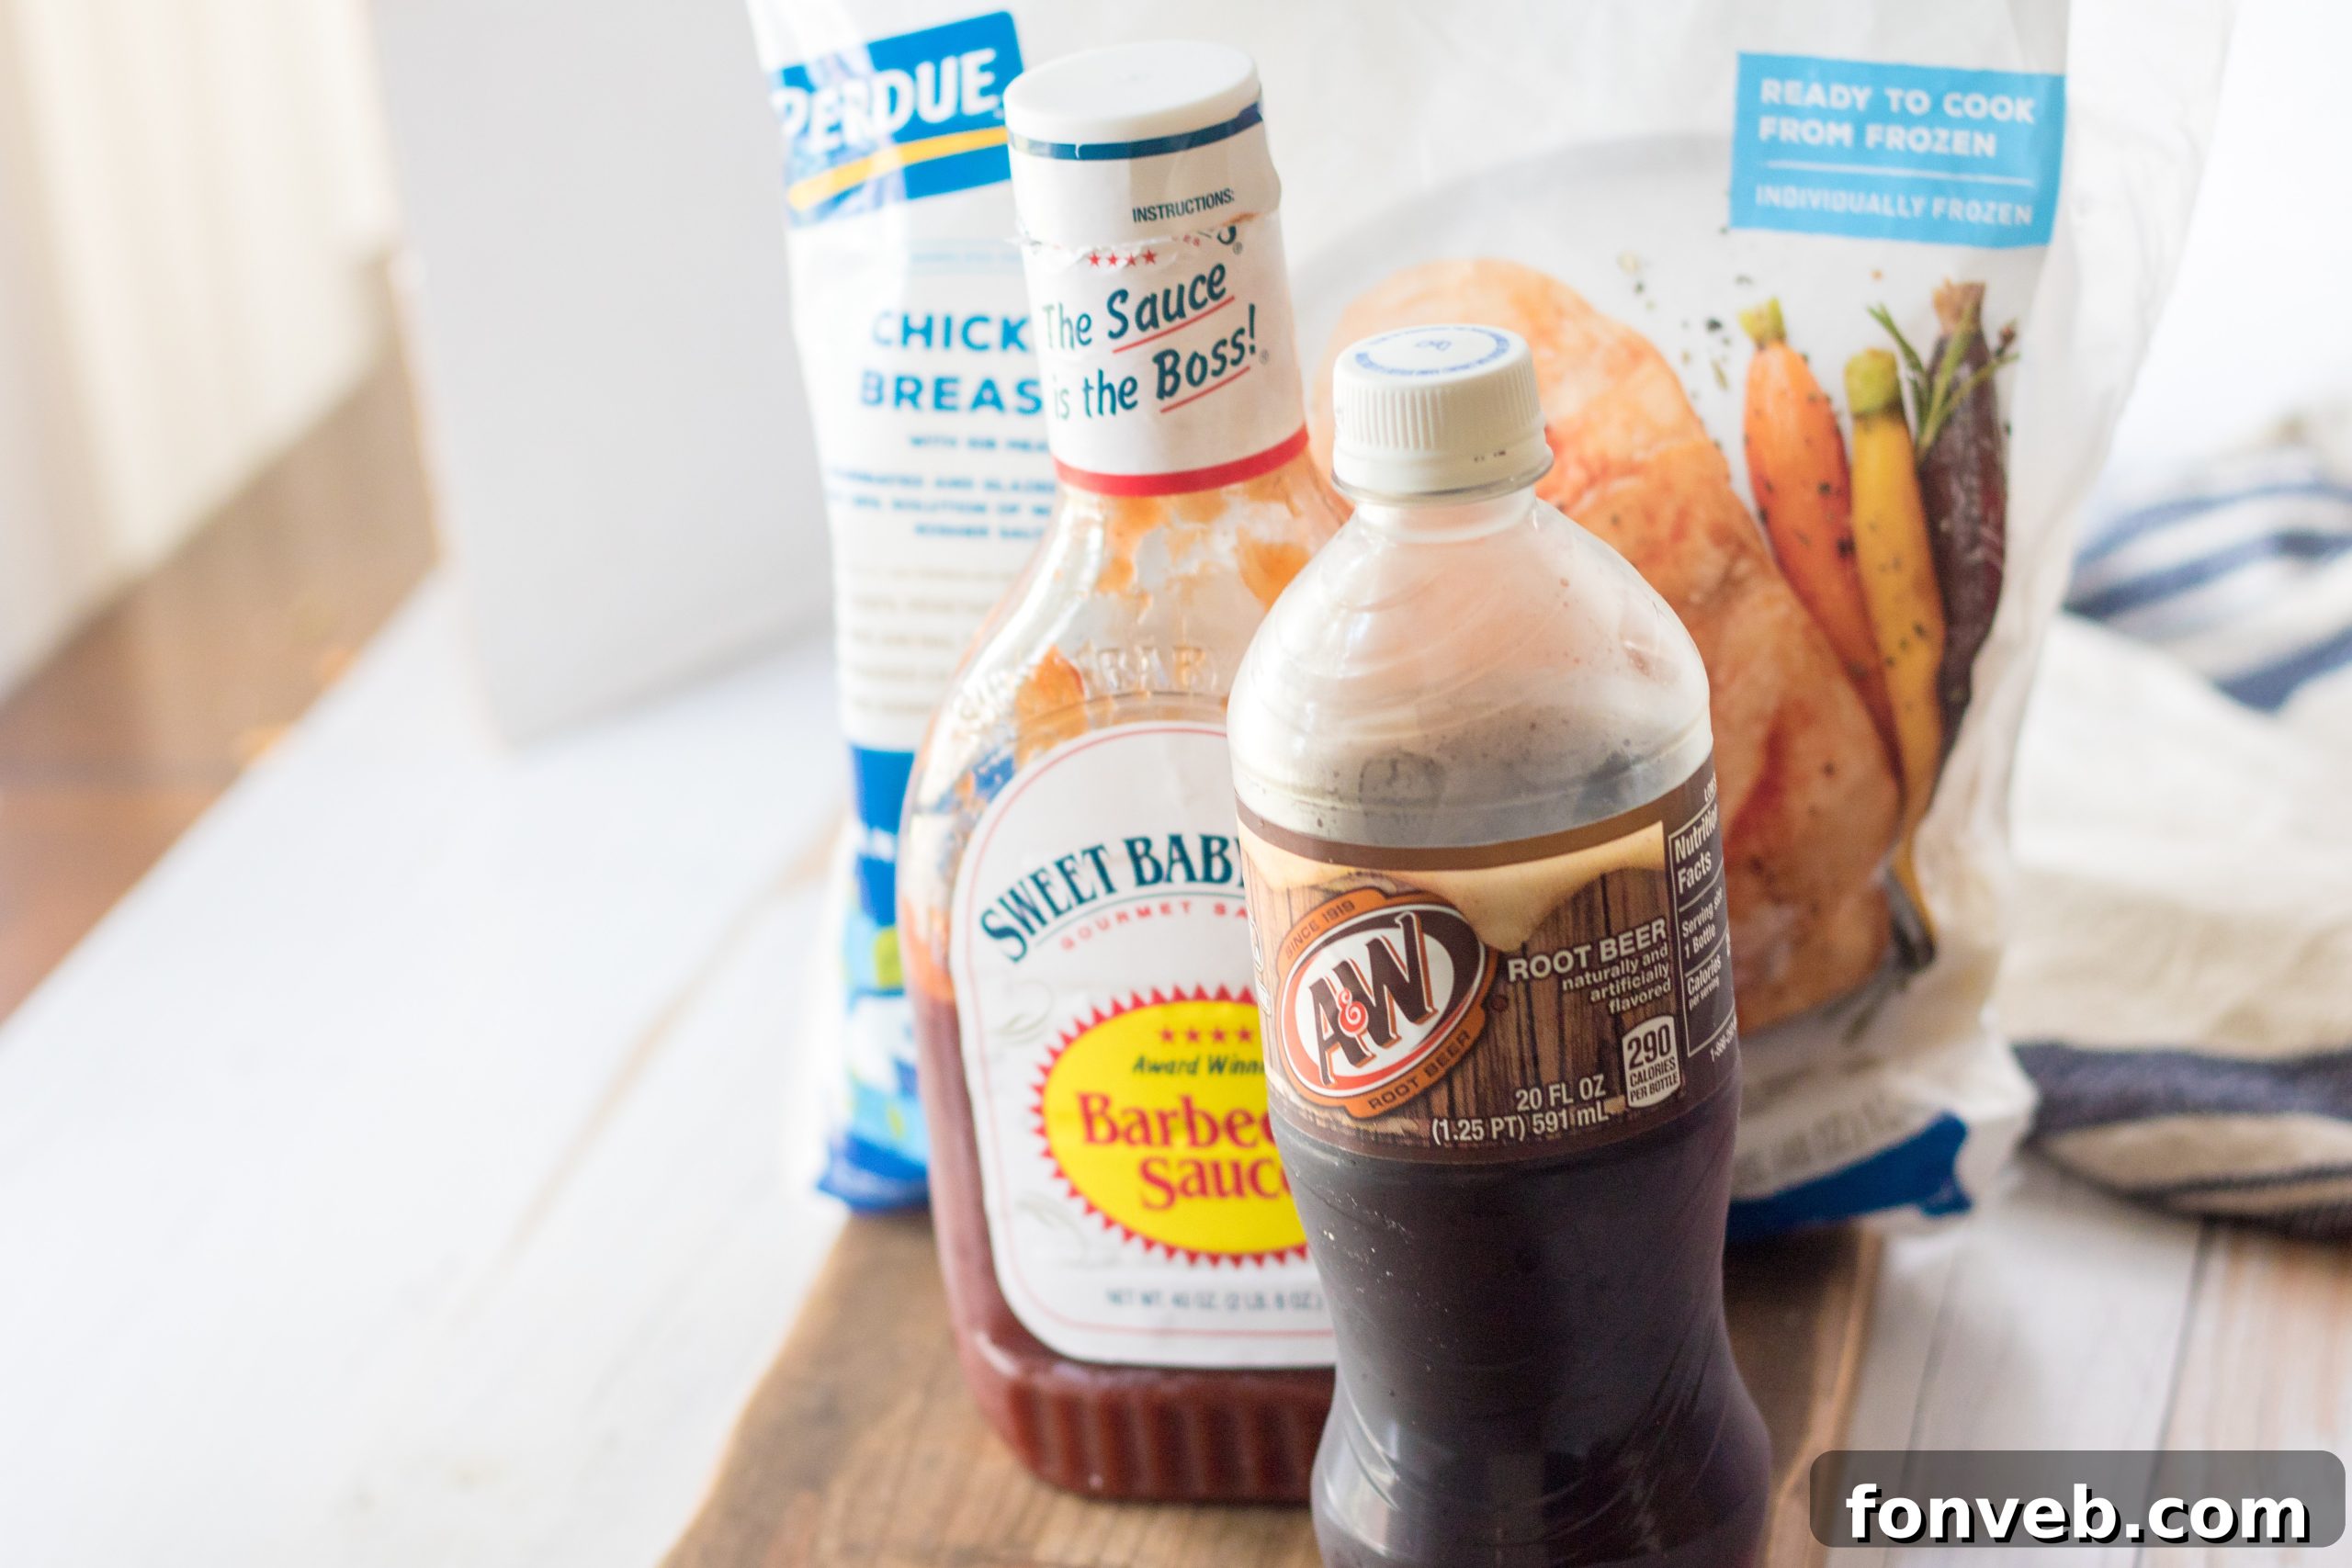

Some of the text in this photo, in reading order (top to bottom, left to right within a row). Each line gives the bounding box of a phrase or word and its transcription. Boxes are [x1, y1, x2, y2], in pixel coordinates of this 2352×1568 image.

[773, 48, 1001, 154] PERDUE
[1760, 78, 2037, 125] READY TO COOK
[1758, 116, 1996, 158] FROM FROZEN
[1132, 187, 1235, 223] INSTRUCTIONS:
[1755, 184, 2034, 226] INDIVIDUALLY FROZEN
[1042, 263, 1227, 350] The Sauce
[1052, 303, 1256, 421] is the Boss!
[1678, 851, 1712, 895] Facts
[980, 833, 1245, 964] SWEET BAB
[1681, 902, 1714, 938] Serving
[1060, 900, 1192, 951] GOURMET
[1285, 919, 1320, 959] SINCE
[1684, 942, 1690, 960] 1
[1692, 923, 1716, 954] Bottle
[1508, 919, 1667, 983] ROOT BEER
[1562, 942, 1668, 991] naturally and
[1590, 963, 1669, 1003] artificially
[1608, 976, 1671, 1015] flavored
[1687, 954, 1722, 996] Calories
[1308, 910, 1439, 1086] A&W
[1132, 1054, 1200, 1076] Award
[1368, 1029, 1471, 1110] ROOT BEER
[1627, 1024, 1671, 1071] 290
[1515, 1073, 1607, 1112] 20 FL OZ
[1629, 1056, 1677, 1088] CALORIES
[1630, 1071, 1679, 1103] PER BOTTLE
[1431, 1100, 1610, 1146] (1.25 PT) 591 mL
[1138, 1155, 1292, 1212] Sauc
